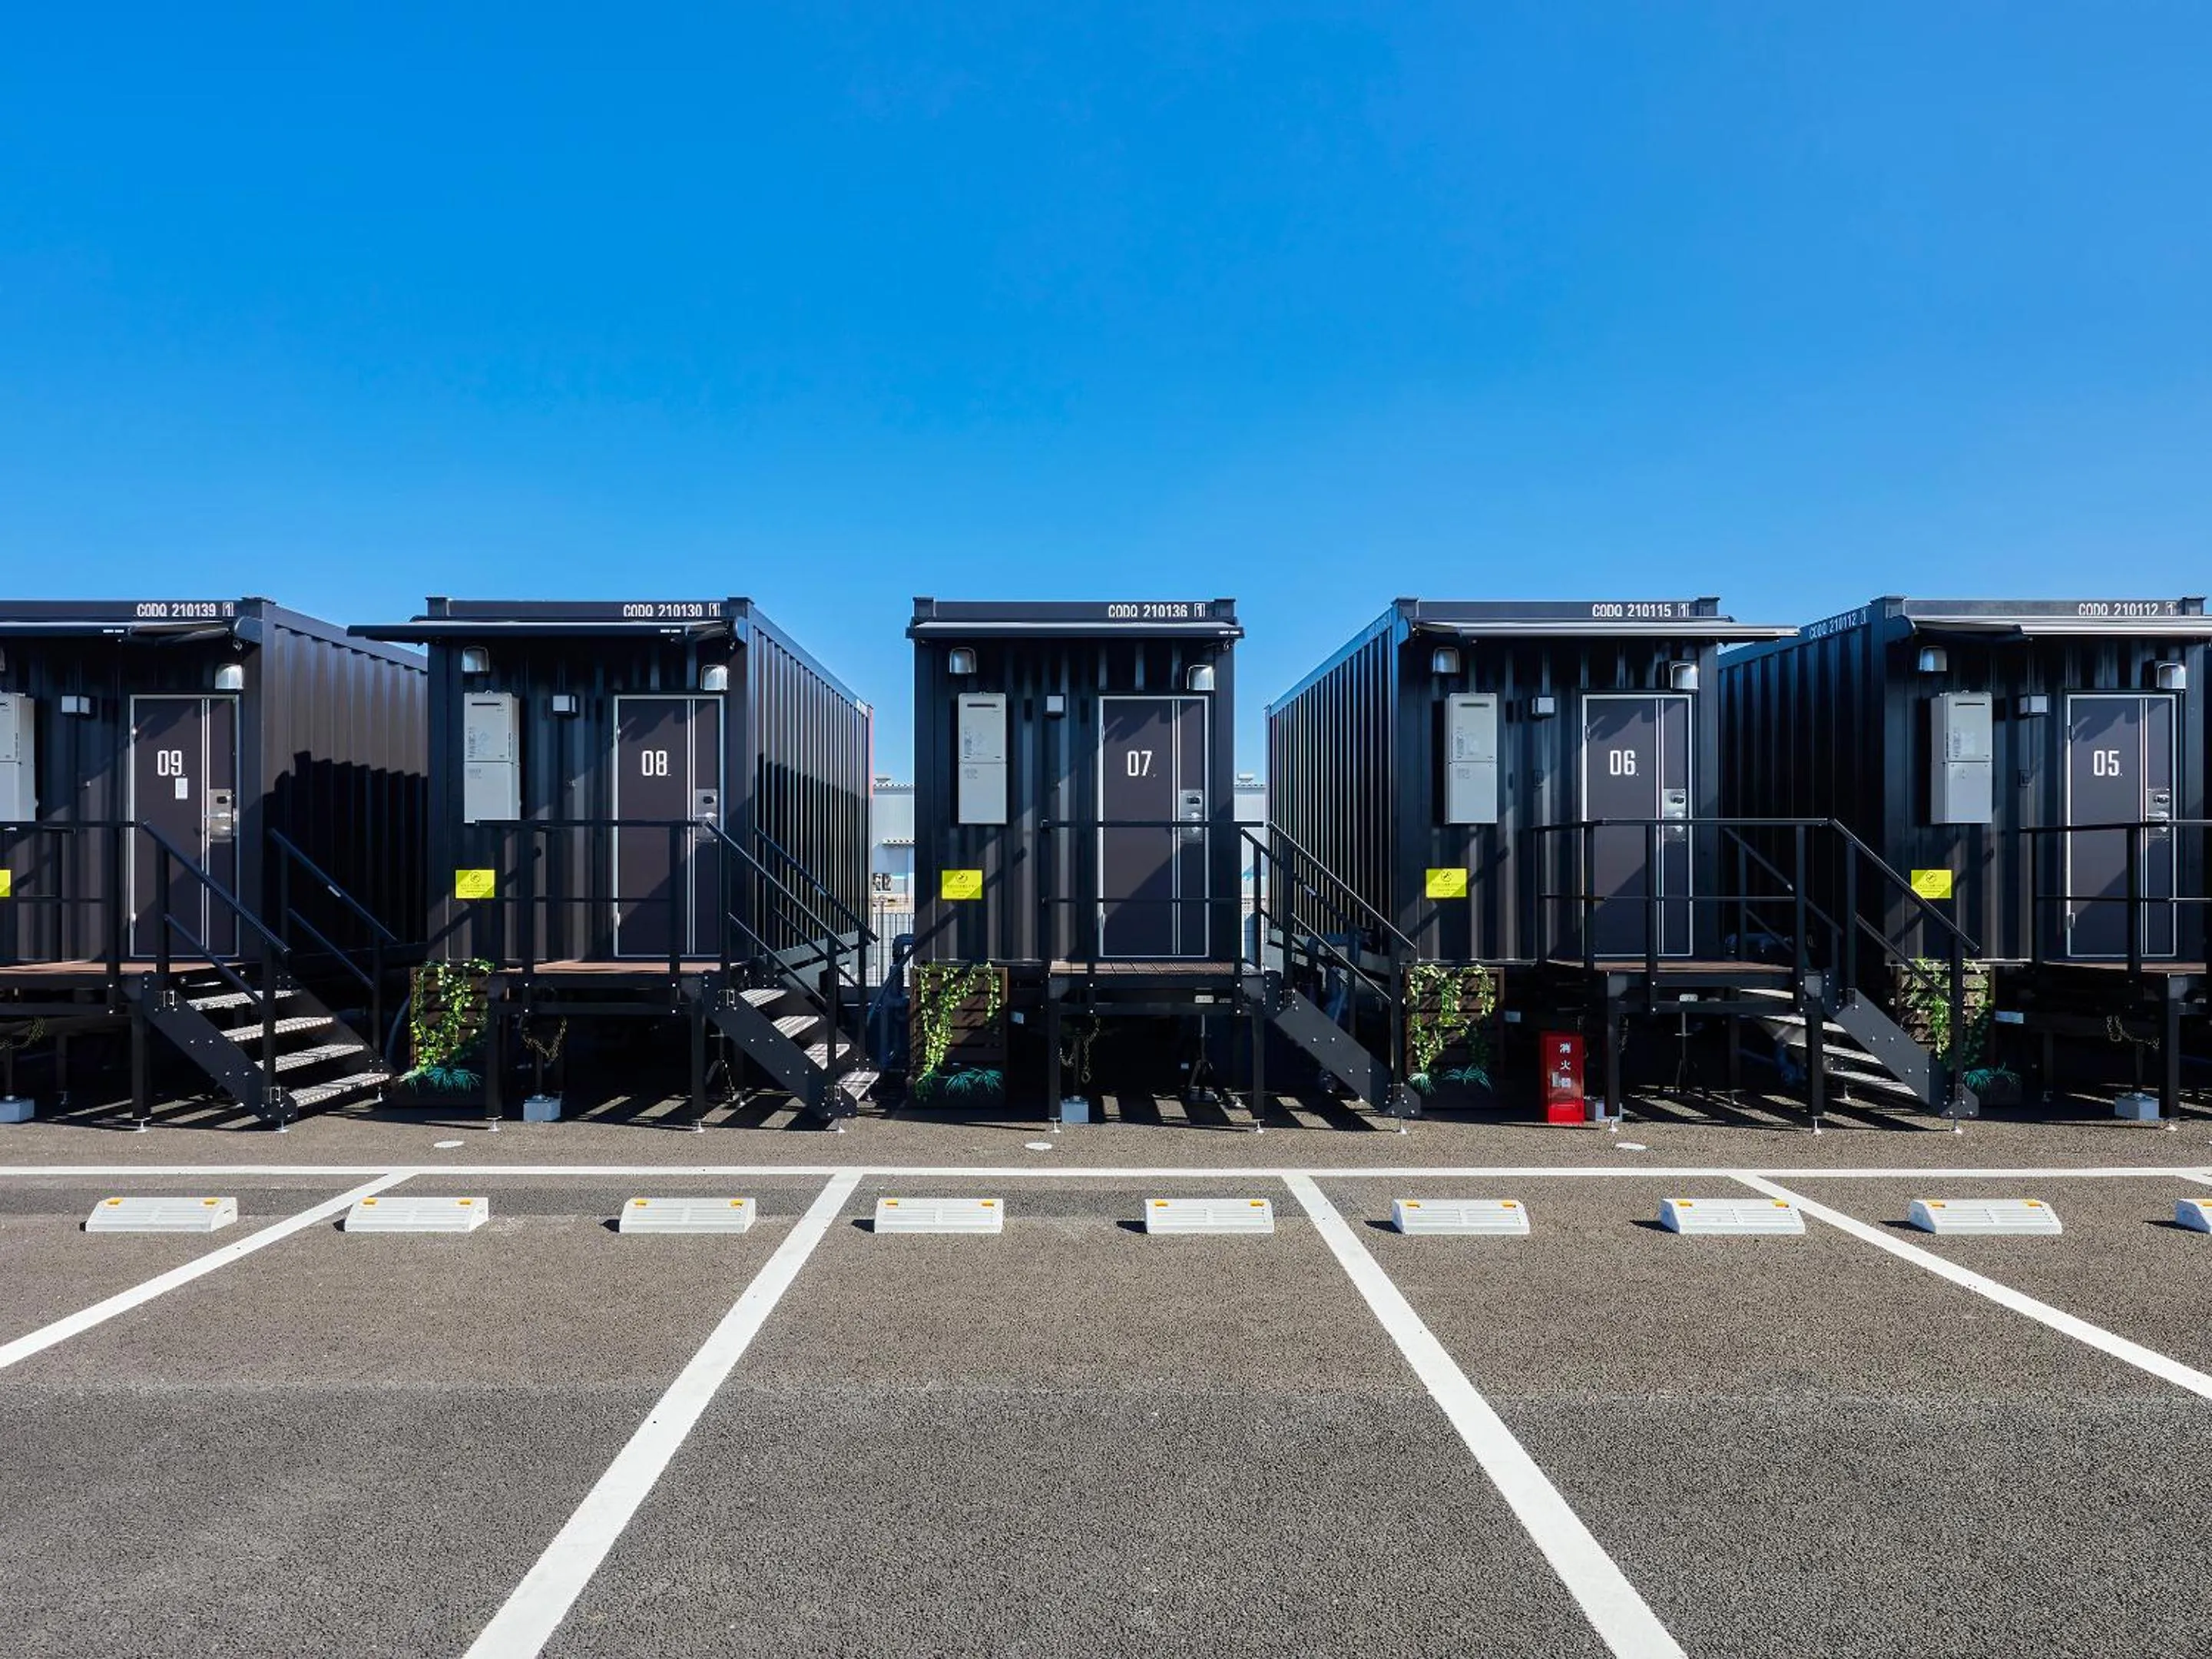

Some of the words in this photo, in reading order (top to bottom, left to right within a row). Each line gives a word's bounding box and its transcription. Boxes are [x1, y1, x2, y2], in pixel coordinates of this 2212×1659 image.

[171, 603, 217, 617] 210139
[658, 604, 703, 617] 210130
[1143, 604, 1188, 618] 210136
[1628, 604, 1672, 617] 210115
[2114, 602, 2159, 615] 210112
